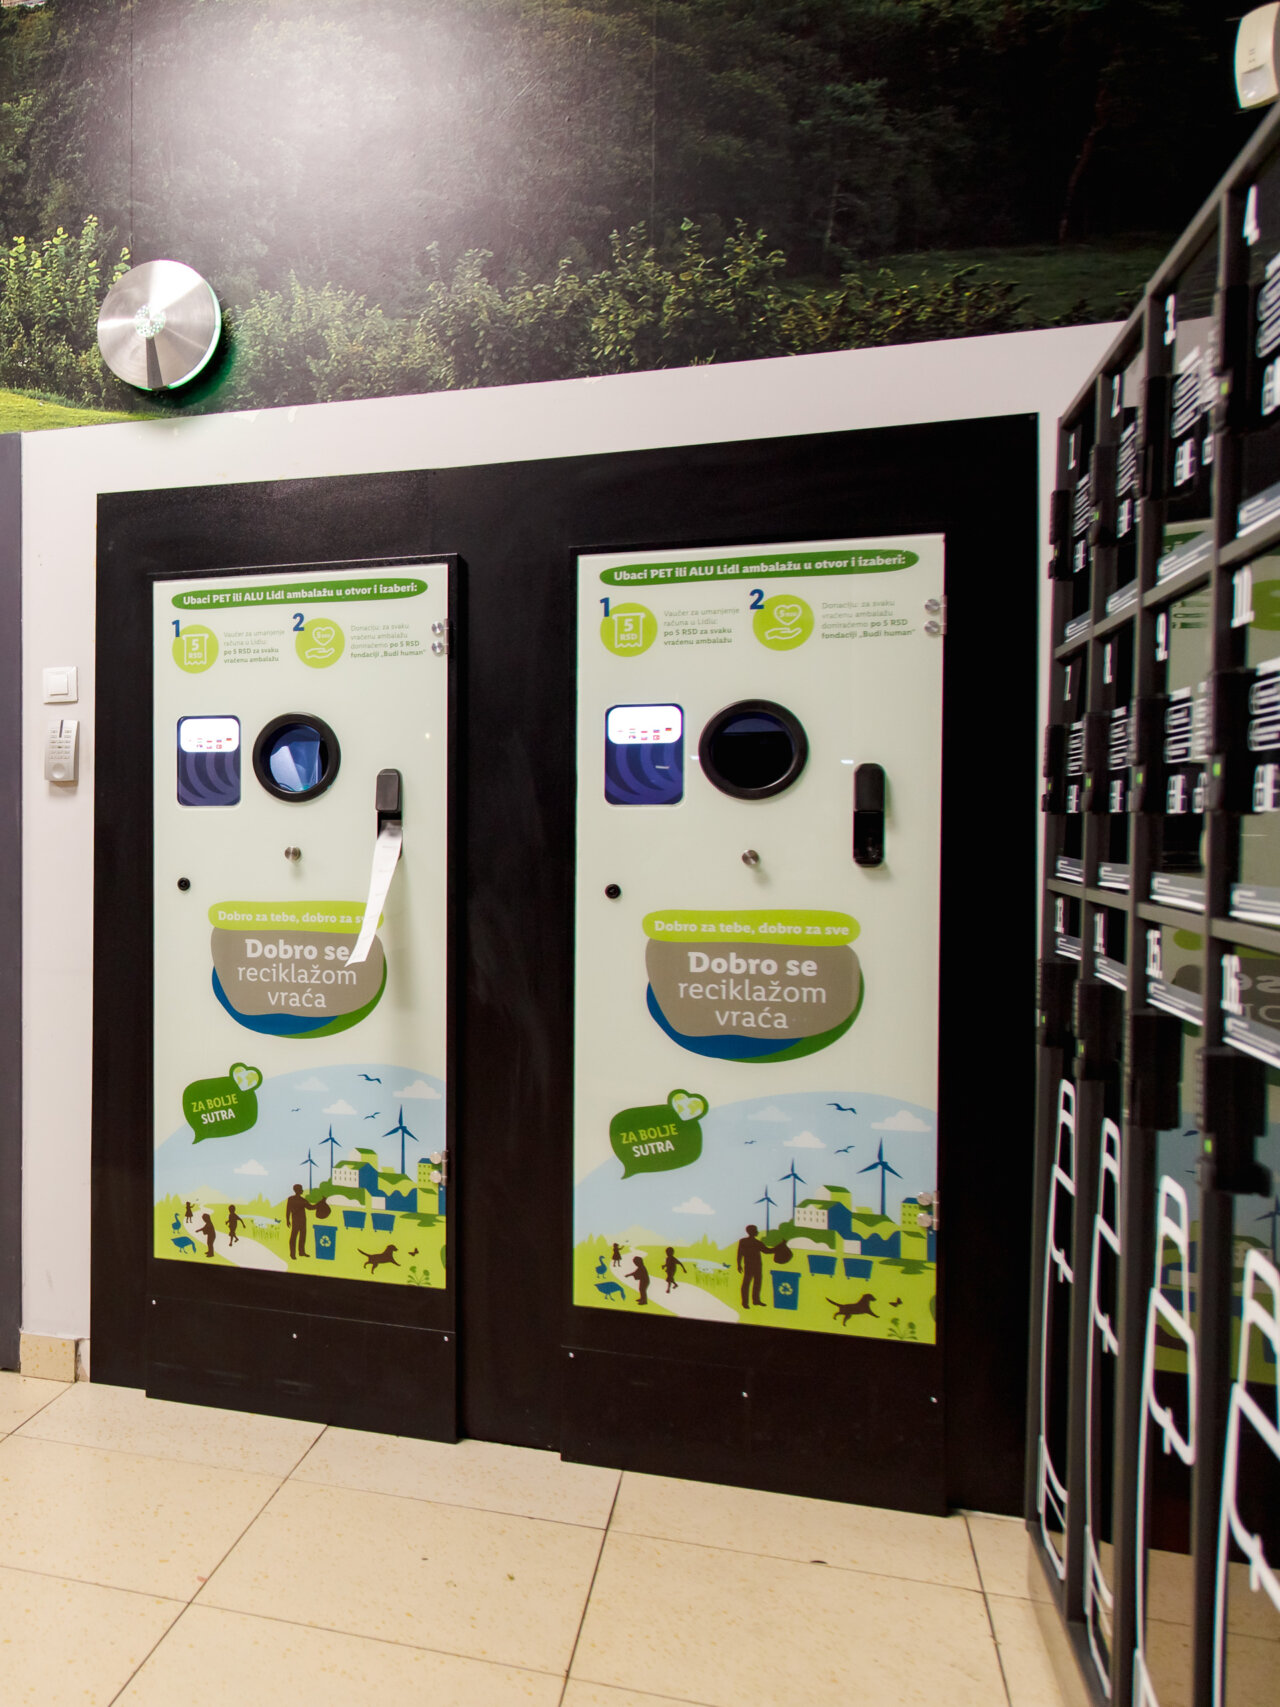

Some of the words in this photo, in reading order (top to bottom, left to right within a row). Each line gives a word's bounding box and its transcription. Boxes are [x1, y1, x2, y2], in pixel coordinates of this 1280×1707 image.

[613, 569, 647, 580] Ubaci
[649, 567, 673, 578] PET
[674, 566, 686, 577] ili
[688, 565, 713, 576] ALU
[716, 563, 739, 574] Lidl
[742, 561, 800, 573] ambalažu
[814, 559, 848, 569] otvor
[850, 556, 855, 566] i
[857, 554, 905, 566] izaberi:
[181, 592, 210, 604] Ubaci
[212, 592, 231, 603] PET
[232, 591, 243, 602] ili
[243, 591, 264, 601] ALU
[265, 590, 285, 600] Lidl
[286, 587, 334, 598] ambalažu
[335, 588, 342, 596] u
[344, 587, 372, 596] otvor
[373, 584, 378, 593] i
[379, 582, 417, 593] izaberi:
[749, 588, 766, 611] 2
[599, 597, 611, 618] 1
[171, 619, 180, 637] 1
[292, 612, 306, 632] 2
[217, 910, 252, 921] Dobro
[255, 913, 267, 921] za
[270, 911, 299, 923] tebe,
[301, 912, 336, 923] dobro
[339, 911, 352, 923] za
[654, 920, 697, 932] Dobro
[700, 923, 716, 932] za
[718, 921, 755, 934] tebe,
[757, 922, 802, 934] dobro
[805, 925, 821, 934] za
[824, 926, 849, 935] sve
[245, 938, 317, 959] Dobro
[324, 941, 349, 961] se
[238, 963, 356, 984] reciklažom
[688, 951, 777, 974] Dobro
[786, 959, 817, 976] se
[267, 988, 325, 1007] vraća
[679, 980, 825, 1002] reciklažom
[715, 1007, 787, 1028] vraća
[191, 1100, 205, 1112] ZA
[206, 1094, 237, 1109] BOLJE
[201, 1108, 235, 1124] SUTRA
[620, 1131, 637, 1144] ZA
[638, 1124, 677, 1140] BOLJE
[632, 1140, 674, 1157] SUTRA
